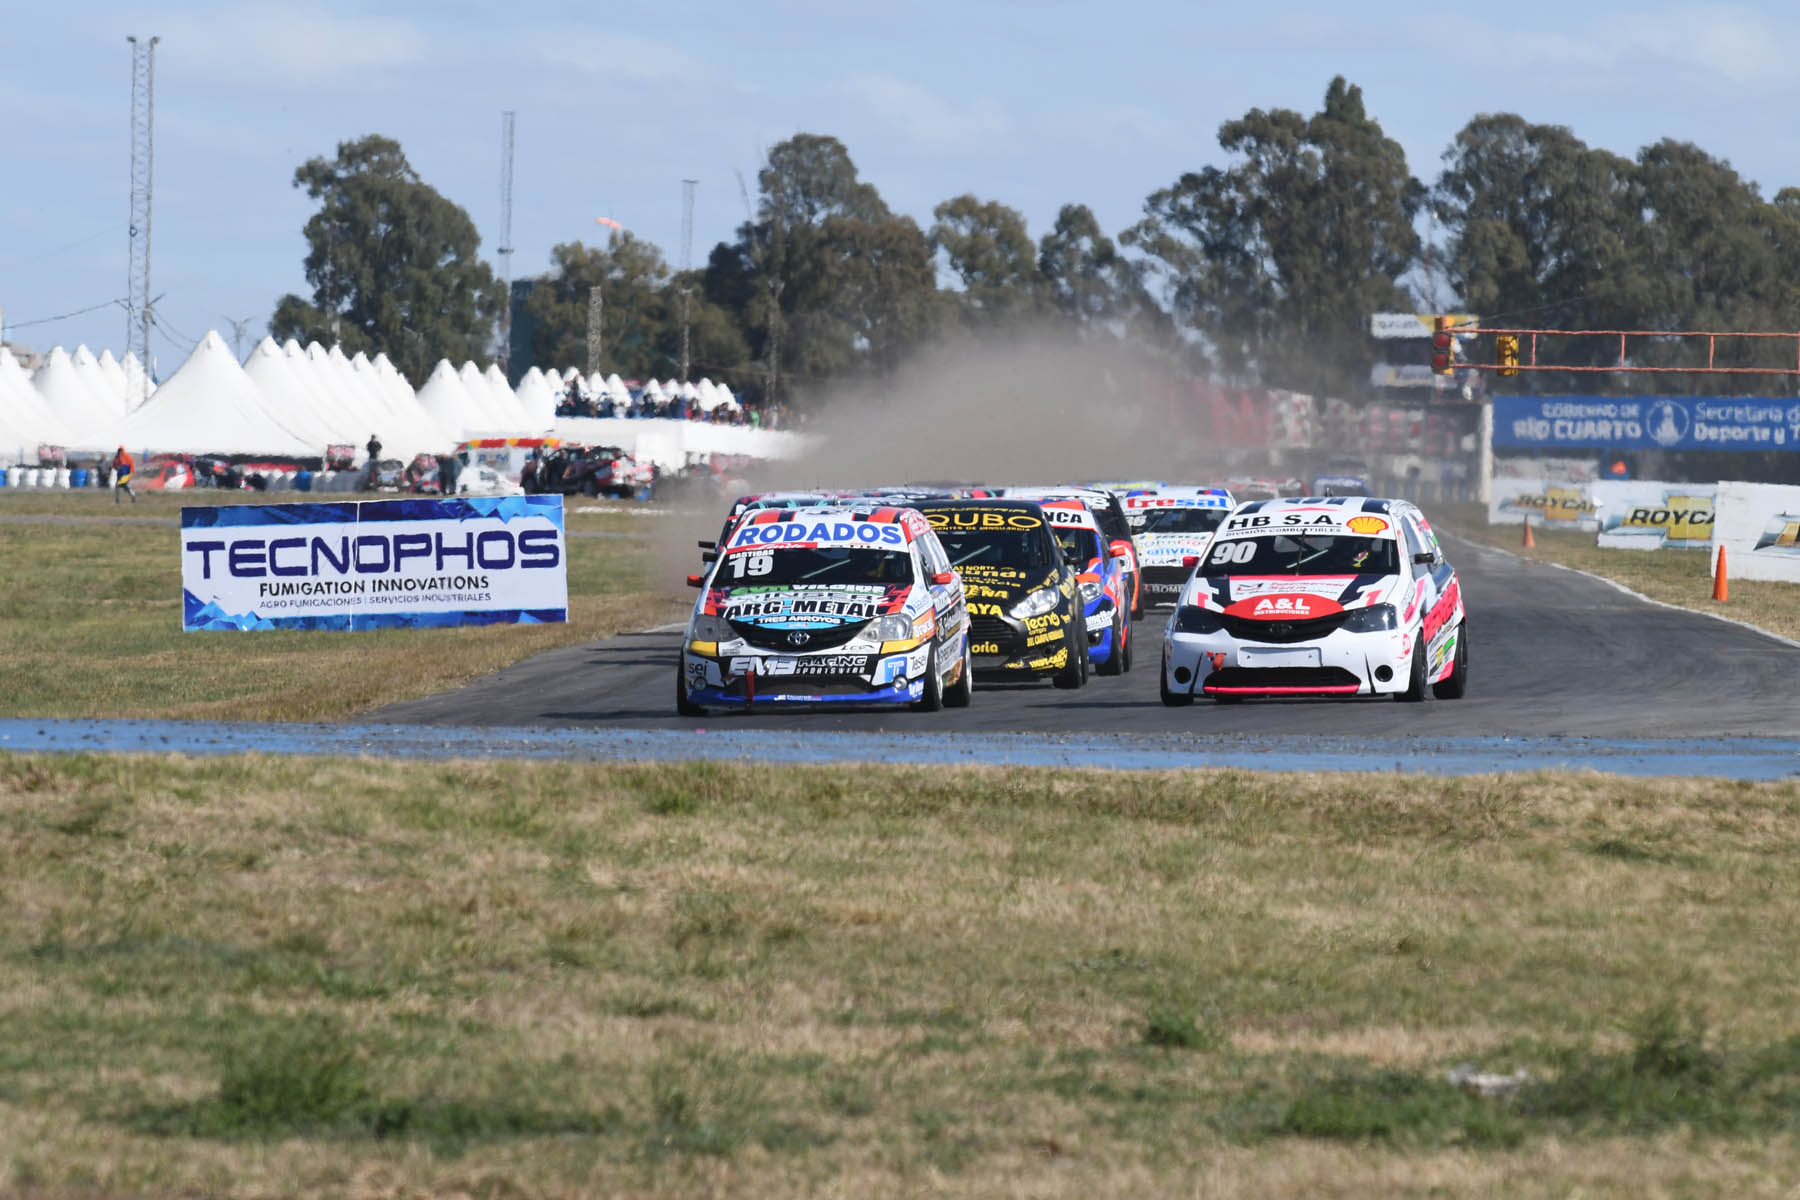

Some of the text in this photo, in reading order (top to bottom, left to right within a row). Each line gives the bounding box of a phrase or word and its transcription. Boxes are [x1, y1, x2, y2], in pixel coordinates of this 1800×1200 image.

[1554, 420, 1642, 440] CUARTO
[1694, 422, 1770, 443] Deporte
[1774, 426, 1786, 445] y
[923, 513, 1042, 528] QUBO
[1228, 514, 1342, 530] HB S.A.
[735, 522, 902, 547] RODADOS
[186, 529, 560, 579] TECNOPHOS
[1210, 541, 1258, 565] 90
[729, 556, 774, 579] 19
[259, 575, 489, 598] FUMIGATION INNOVATIONS
[259, 592, 492, 609] AGRO FUMIGACIONES SERVICIOS INDUSTRIALES
[1254, 598, 1311, 611] A&L
[758, 616, 787, 624] TRES
[788, 615, 842, 625] ARROYOS
[798, 655, 868, 667] RACING
